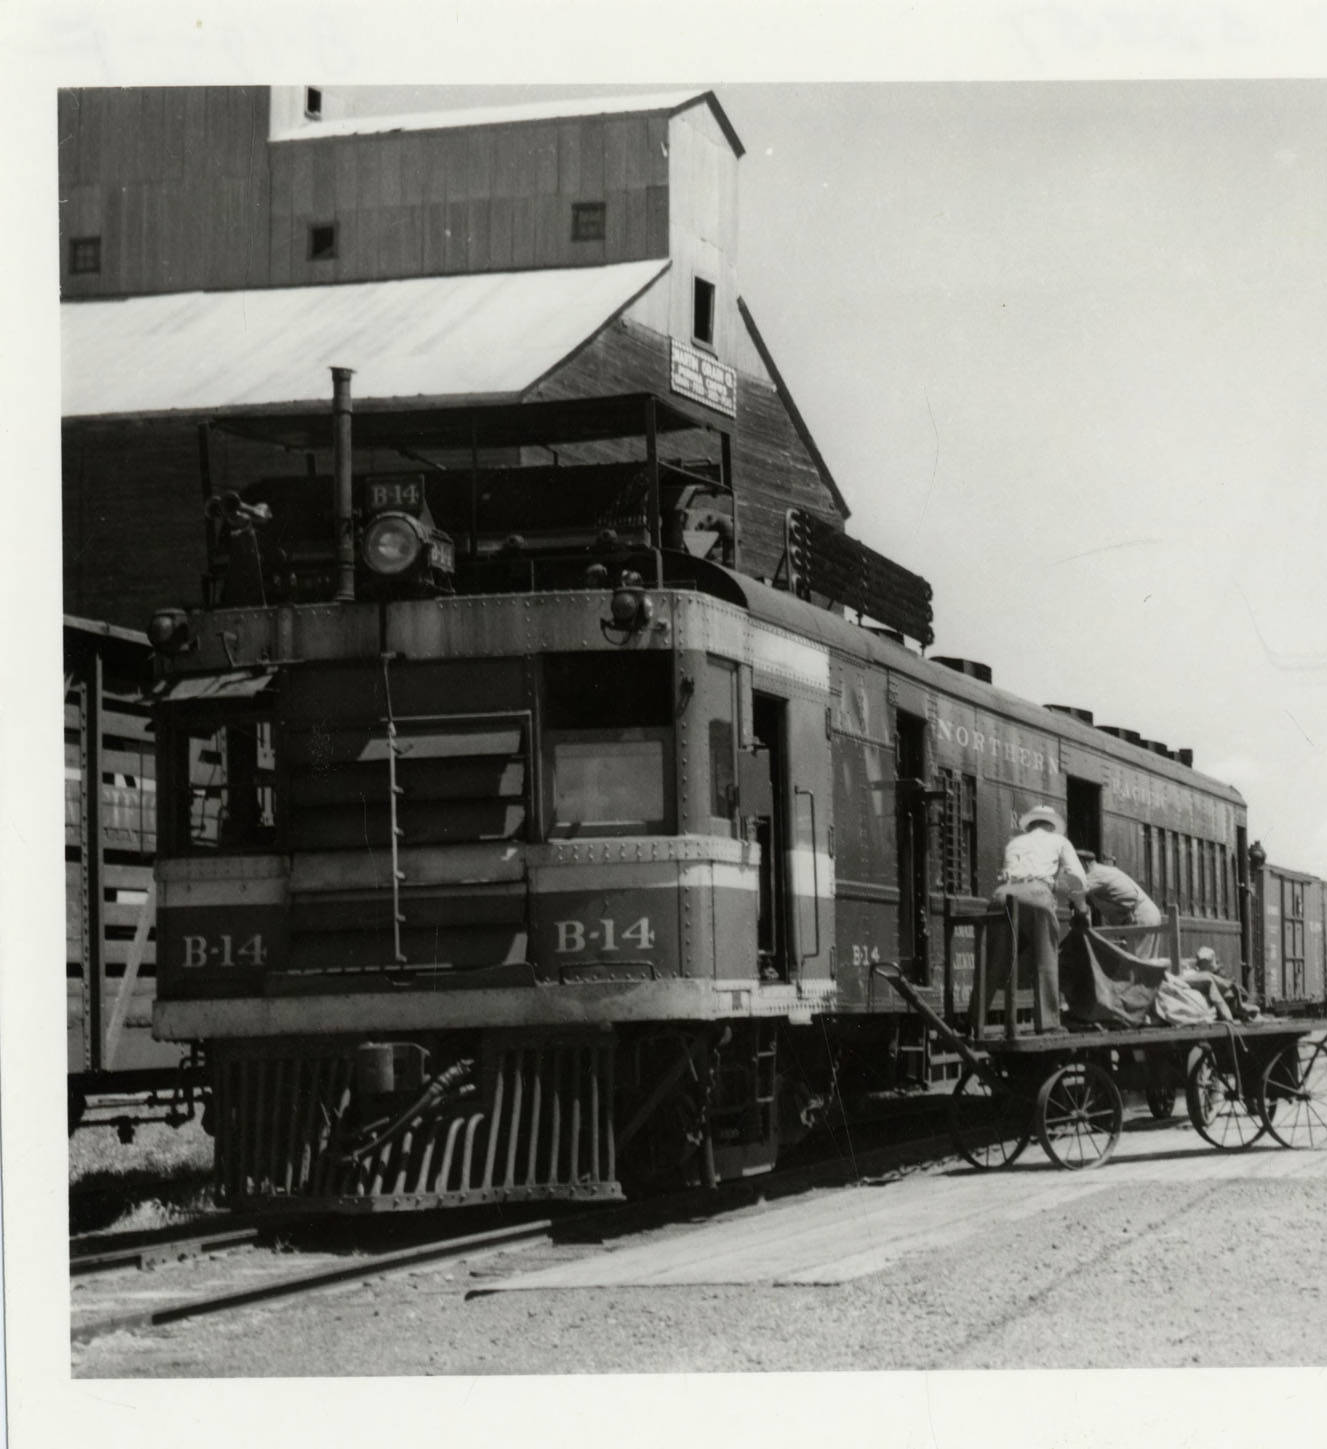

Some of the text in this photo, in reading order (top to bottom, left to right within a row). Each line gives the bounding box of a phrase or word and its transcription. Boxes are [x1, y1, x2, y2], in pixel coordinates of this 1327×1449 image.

[372, 484, 419, 507] B-14
[938, 718, 1060, 775] NORTHERN
[182, 933, 268, 968] B-14
[554, 917, 656, 953] B-14
